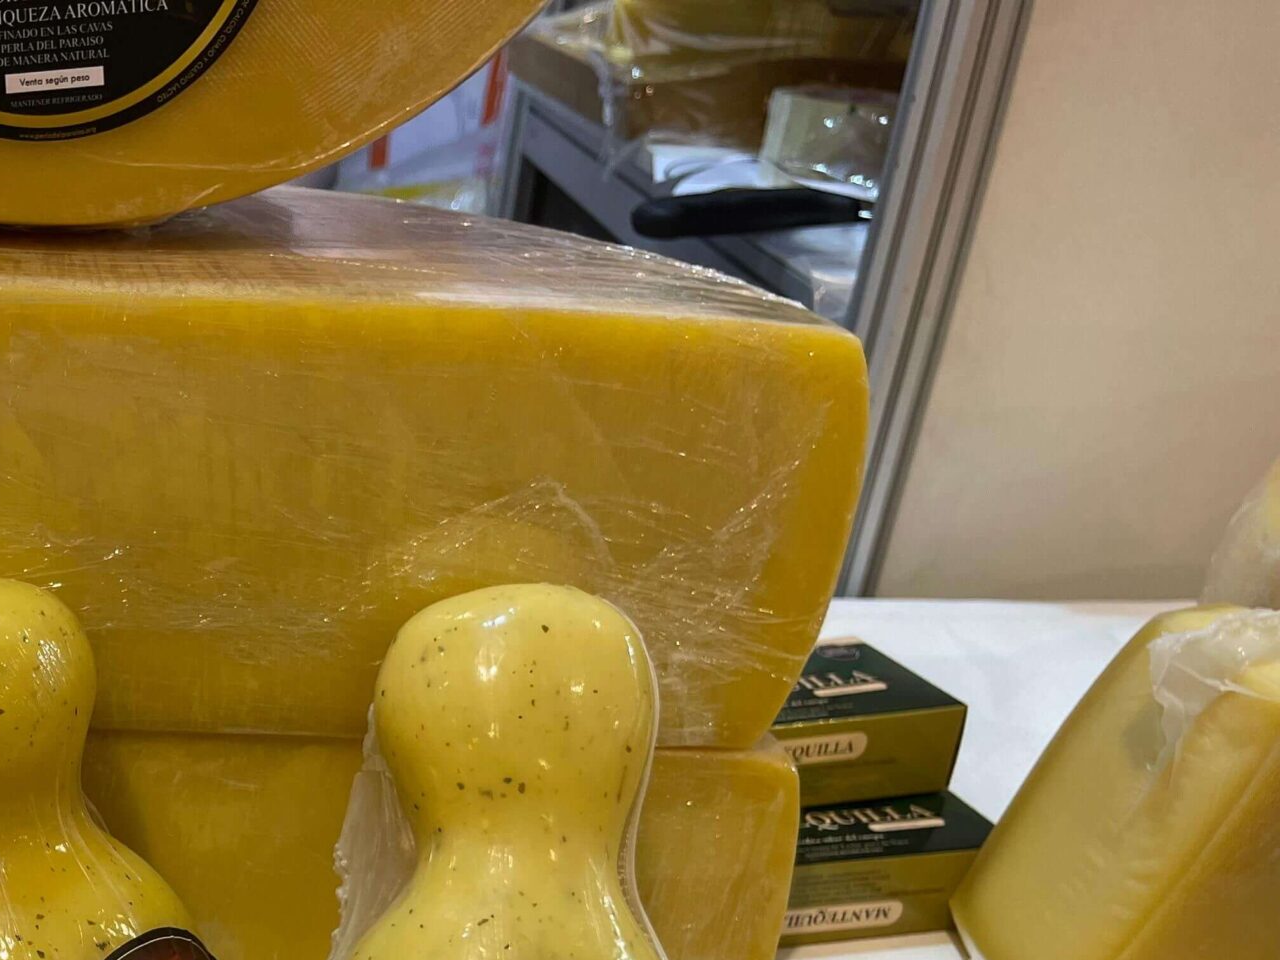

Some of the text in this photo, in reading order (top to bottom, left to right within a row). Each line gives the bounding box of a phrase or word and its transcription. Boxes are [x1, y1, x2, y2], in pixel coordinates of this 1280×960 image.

[41, 26, 56, 36] EN
[58, 24, 78, 35] LAS
[79, 21, 113, 33] CAVAS
[1, 36, 104, 54] PERLA DEL PARAISO
[12, 52, 59, 66] MANERA
[61, 49, 110, 62] NATURAL
[20, 74, 90, 87] Venta según peso
[784, 906, 891, 928] MANTEQUIL
